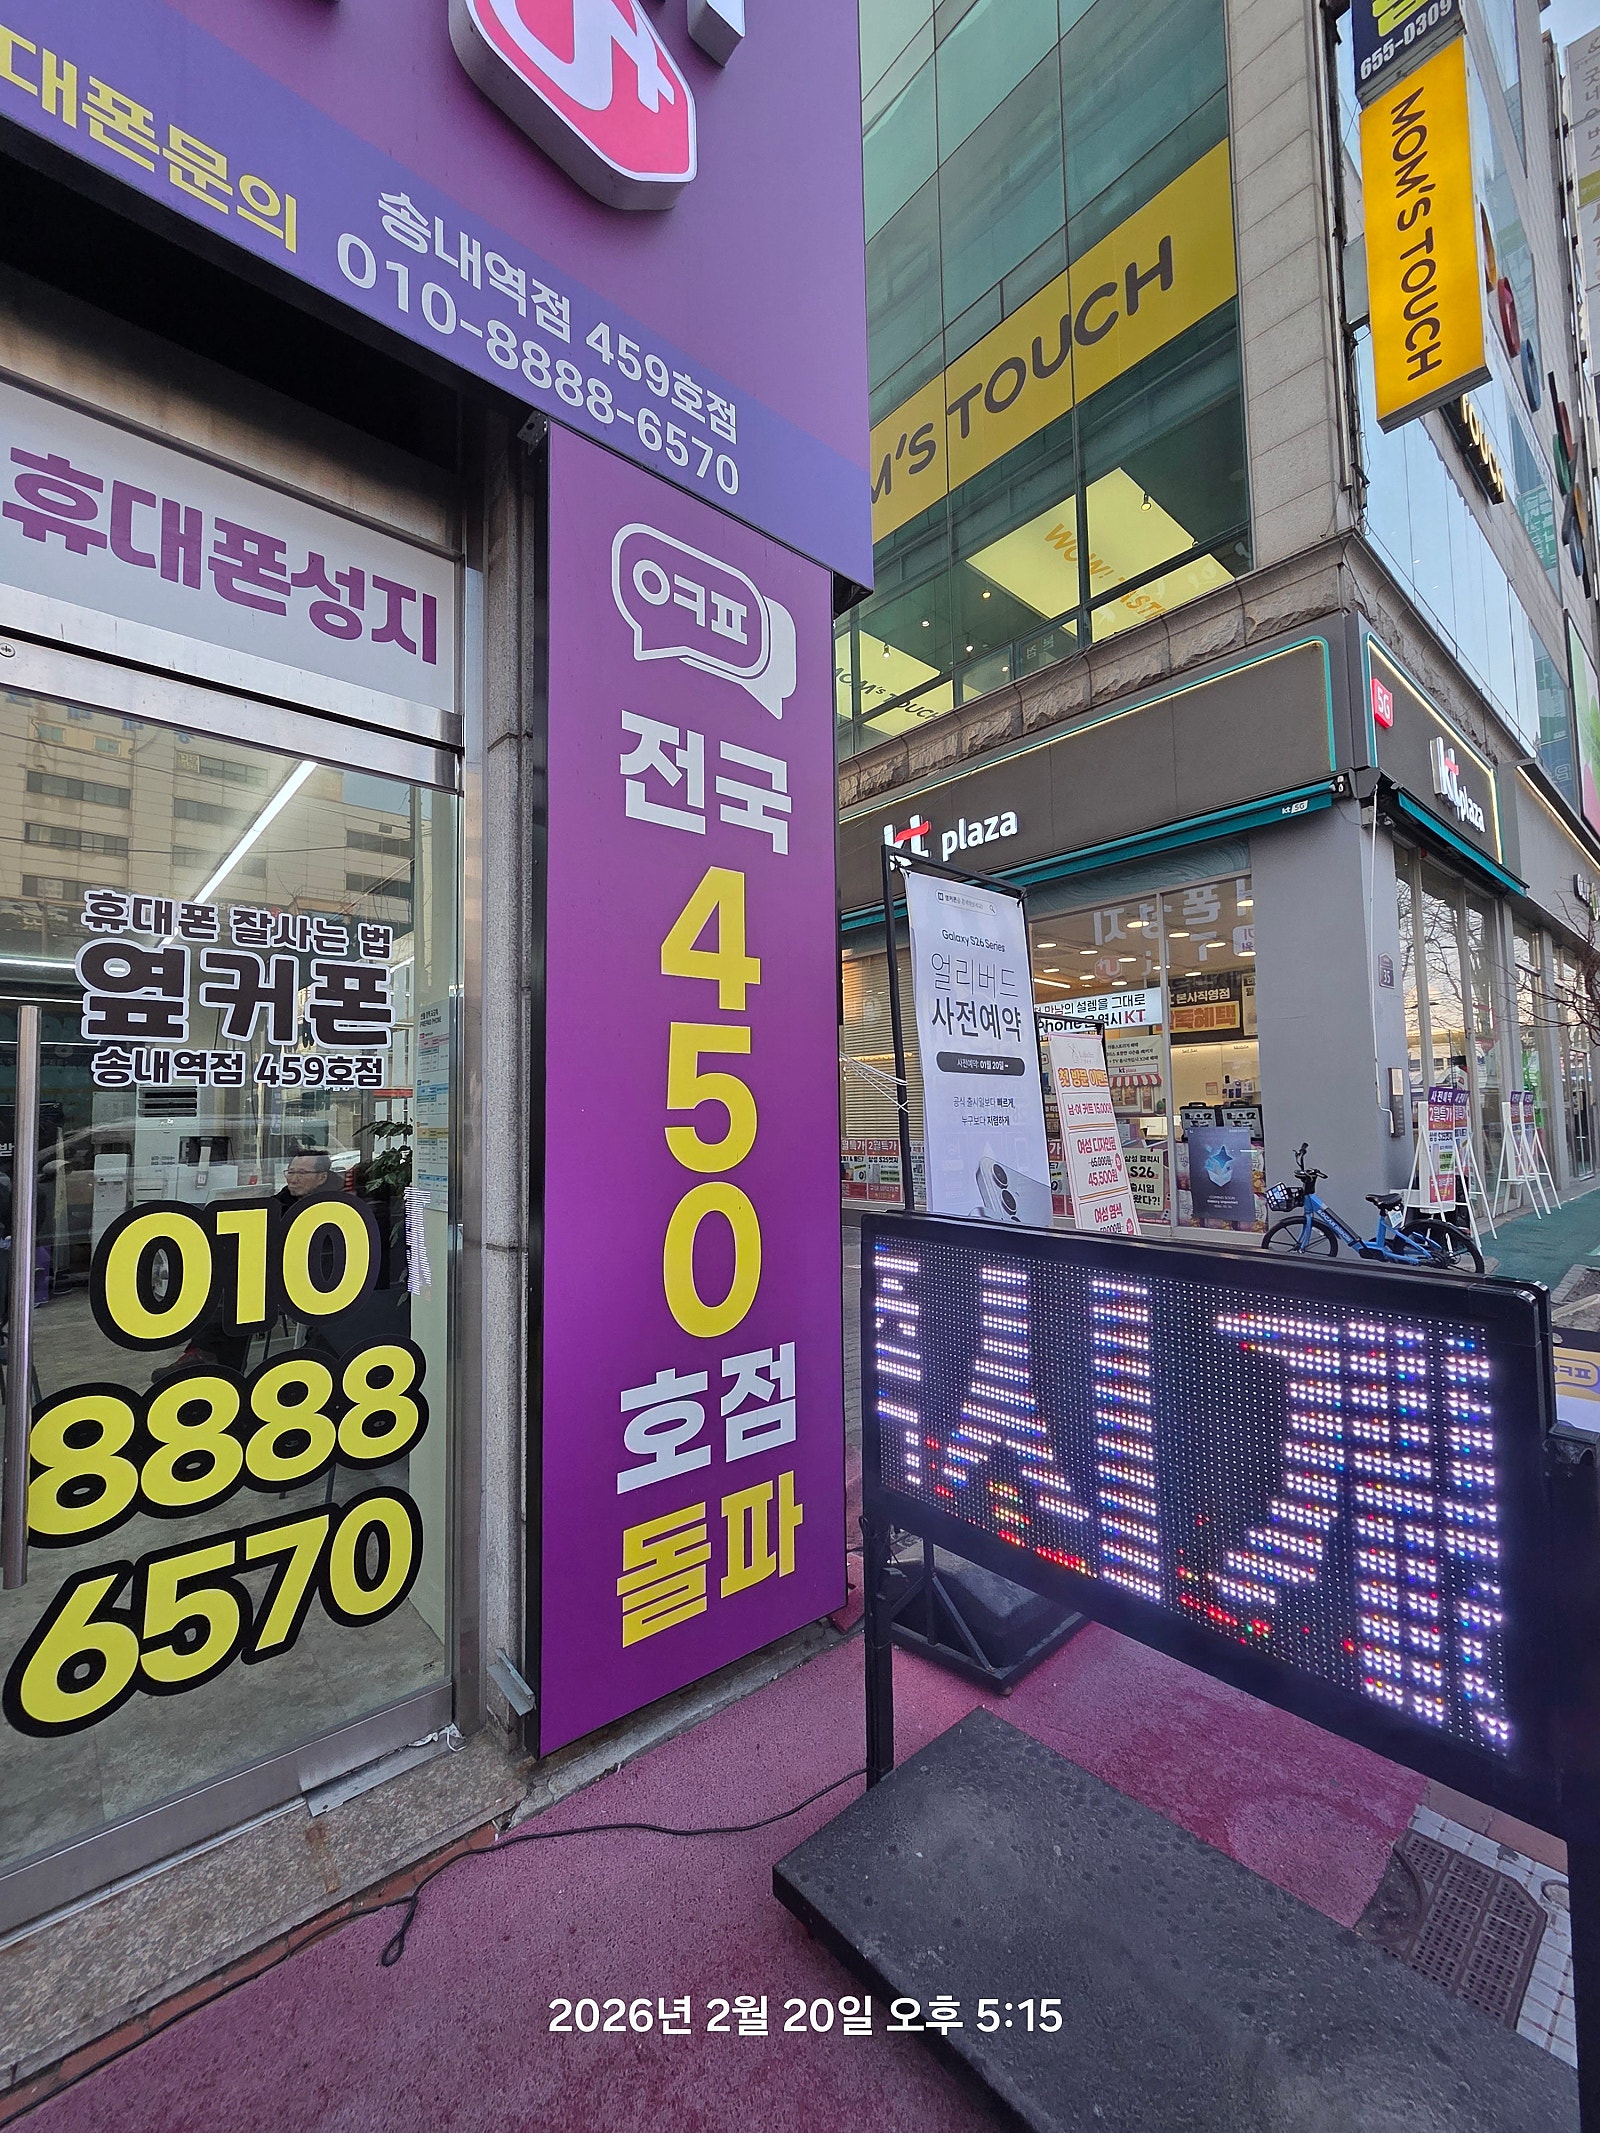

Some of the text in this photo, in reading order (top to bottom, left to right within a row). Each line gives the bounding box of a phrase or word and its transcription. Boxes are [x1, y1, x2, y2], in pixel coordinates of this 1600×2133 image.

[1360, 0, 1452, 80] 655-0309
[1391, 87, 1436, 232] MOM'S
[379, 191, 738, 445] 송내역점 459호점
[1400, 226, 1442, 382] TOUCH
[947, 236, 1175, 441] TOUCH
[336, 232, 740, 496] 010-8888-6570
[2, 447, 437, 665] 휴대폰성지
[1377, 686, 1391, 720] 5G
[620, 709, 792, 855] 전국
[1456, 786, 1485, 833] plaza
[941, 807, 1018, 862] plaza
[82, 889, 393, 959] 휴대폰 잘사는 법
[942, 929, 1006, 952] Galaxy S26 Series
[76, 938, 397, 1049] 옆커폰
[931, 953, 1018, 999] 얼리버드
[1176, 988, 1230, 1004] 본사직영점
[1383, 969, 1391, 984] 35
[931, 997, 1021, 1042] 사전예약
[1077, 998, 1109, 1014] 설렘을
[1112, 993, 1146, 1009] 그대로
[1125, 1009, 1146, 1024] KT
[92, 1046, 385, 1088] 송내역점 459호점
[1058, 1068, 1070, 1087] 첫
[1072, 1068, 1090, 1087] 방문
[953, 1096, 965, 1108] 공식
[966, 1097, 996, 1109] 출시일보다
[961, 1115, 1010, 1126] 누구보다 저렴하게
[1083, 1103, 1094, 1114] 커트
[868, 1140, 897, 1151] 2월특가
[1077, 1138, 1092, 1154] 여성
[1124, 1154, 1138, 1163] 삼성
[1088, 1168, 1119, 1187] 45,500원
[1131, 1167, 1154, 1179] S26
[1094, 1202, 1124, 1223] 여성 염색
[102, 1200, 371, 1341] 010
[28, 1343, 420, 1537] 8888
[617, 1341, 796, 1495] 호점
[617, 1470, 803, 1648] 돌파
[19, 1495, 415, 1724] 6570
